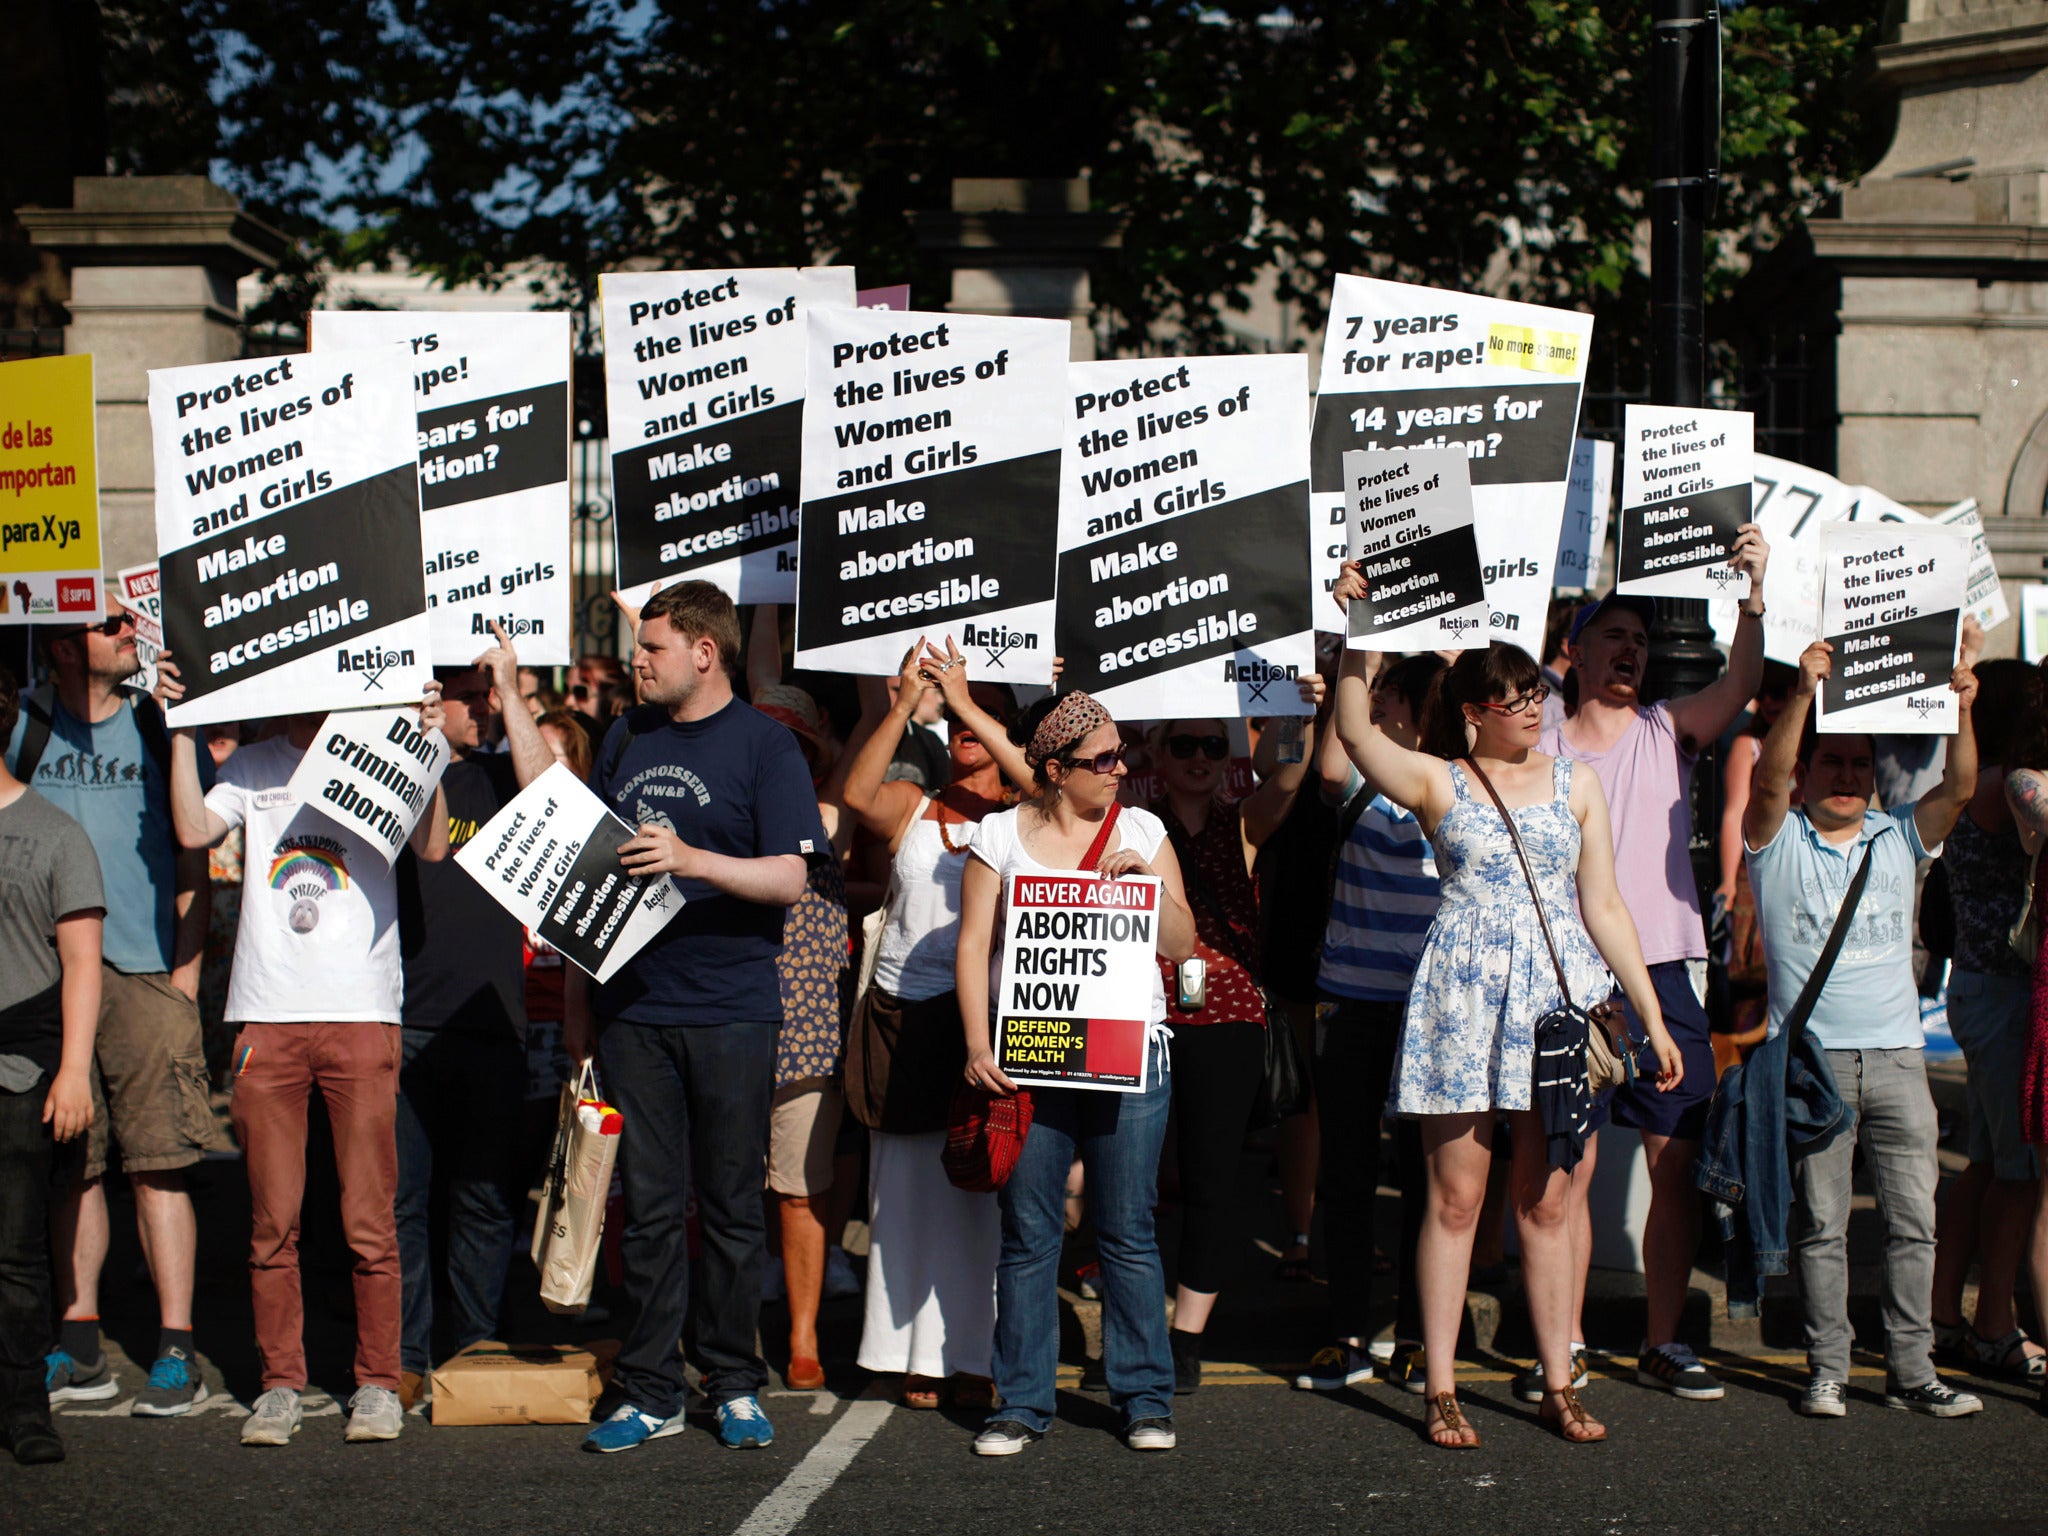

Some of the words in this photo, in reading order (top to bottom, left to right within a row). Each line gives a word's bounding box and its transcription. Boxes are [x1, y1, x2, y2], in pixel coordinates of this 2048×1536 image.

[630, 276, 739, 326] Protect
[634, 336, 681, 363] the
[689, 315, 757, 348] lives
[766, 296, 795, 326] of
[833, 323, 949, 368] Protect
[1346, 316, 1363, 340] 7
[1373, 314, 1458, 344] years
[1489, 335, 1504, 351] No
[1506, 340, 1534, 354] more
[1342, 350, 1391, 375] for
[1402, 342, 1484, 373] rape!
[176, 358, 295, 420] Protect
[637, 356, 748, 400] Women
[834, 380, 883, 408] the
[893, 366, 965, 397] lives
[975, 349, 1008, 379] of
[1075, 365, 1190, 420] Protect
[181, 426, 231, 456] the
[240, 396, 312, 436] lives
[322, 373, 353, 406] of
[485, 403, 534, 434] for
[644, 402, 697, 438] and
[707, 385, 775, 419] Girls
[834, 410, 951, 448] Women
[1078, 423, 1130, 458] the
[1137, 405, 1208, 441] lives
[1218, 386, 1250, 417] of
[1350, 407, 1386, 432] 14
[1396, 404, 1483, 435] years
[1494, 395, 1543, 421] for
[3, 421, 23, 450] de
[27, 420, 53, 447] las
[1641, 420, 1698, 442] Protect
[1642, 448, 1667, 462] the
[1671, 438, 1707, 457] lives
[1710, 433, 1725, 447] of
[183, 435, 306, 498] Women
[648, 443, 731, 481] Make
[837, 454, 892, 489] and
[904, 441, 977, 474] Girls
[1081, 449, 1198, 497] Women
[1358, 462, 1410, 492] Protect
[1642, 462, 1701, 483] Women
[192, 500, 249, 537] and
[260, 469, 332, 509] Girls
[655, 472, 779, 521] abortion
[1087, 501, 1143, 537] and
[1154, 479, 1226, 515] Girls
[1359, 496, 1382, 512] the
[1385, 484, 1420, 504] lives
[1423, 473, 1439, 491] of
[1643, 484, 1672, 502] and
[1678, 477, 1714, 494] Girls
[2, 522, 39, 551] para
[42, 514, 56, 541] X
[58, 519, 81, 549] ya
[659, 505, 800, 563] accessible
[838, 499, 925, 535] Make
[1360, 508, 1416, 533] Women
[1576, 511, 1600, 534] TO
[1644, 506, 1689, 525] Make
[1363, 534, 1391, 555] and
[1396, 524, 1431, 544] Girls
[1644, 525, 1713, 547] abortion
[197, 534, 286, 583] Make
[840, 537, 974, 580] abortion
[1090, 541, 1178, 583] Make
[1366, 557, 1411, 578] Make
[1482, 557, 1538, 585] girls
[1644, 543, 1725, 570] accessible
[1843, 545, 1904, 568] Protect
[1843, 575, 1870, 589] the
[1875, 564, 1913, 585] lives
[1918, 558, 1935, 574] of
[69, 588, 92, 602] SIPTU
[129, 574, 160, 597] NEV
[204, 562, 340, 630] abortion
[447, 575, 491, 603] and
[500, 562, 555, 595] girls
[842, 574, 999, 625] accessible
[1095, 573, 1229, 628] abortion
[1371, 573, 1439, 602] abortion
[1844, 589, 1905, 611] Women
[1372, 591, 1455, 626] accessible
[1844, 613, 1874, 630] and
[1880, 605, 1918, 623] Girls
[210, 595, 369, 673] accessible
[1097, 607, 1257, 674] accessible
[1844, 635, 1890, 654] Make
[1844, 652, 1913, 677] abortion
[1845, 671, 1925, 701] accessible
[386, 716, 439, 773] Don't
[325, 733, 431, 818] criminali
[616, 764, 711, 807] CONNOISSEUR
[642, 784, 686, 799] NW&B
[485, 812, 528, 871] Protect
[502, 857, 523, 883] the
[517, 819, 546, 856] lives
[544, 797, 558, 817] of
[517, 835, 558, 897] Women
[537, 878, 558, 911] and
[554, 841, 580, 877] Girls
[288, 883, 328, 901] PRIDE
[553, 881, 586, 925] Make
[575, 873, 617, 937] abortion
[1021, 883, 1081, 903] NEVER
[1084, 884, 1146, 906] AGAIN
[594, 874, 644, 950] accessible
[1015, 911, 1150, 943] ABORTION
[1015, 947, 1107, 977] RIGHTS
[1013, 982, 1080, 1011] NOW
[1006, 1035, 1084, 1049] WOMEN'S
[1007, 1020, 1071, 1034] DEFEND
[1006, 1050, 1065, 1063] HEALTH
